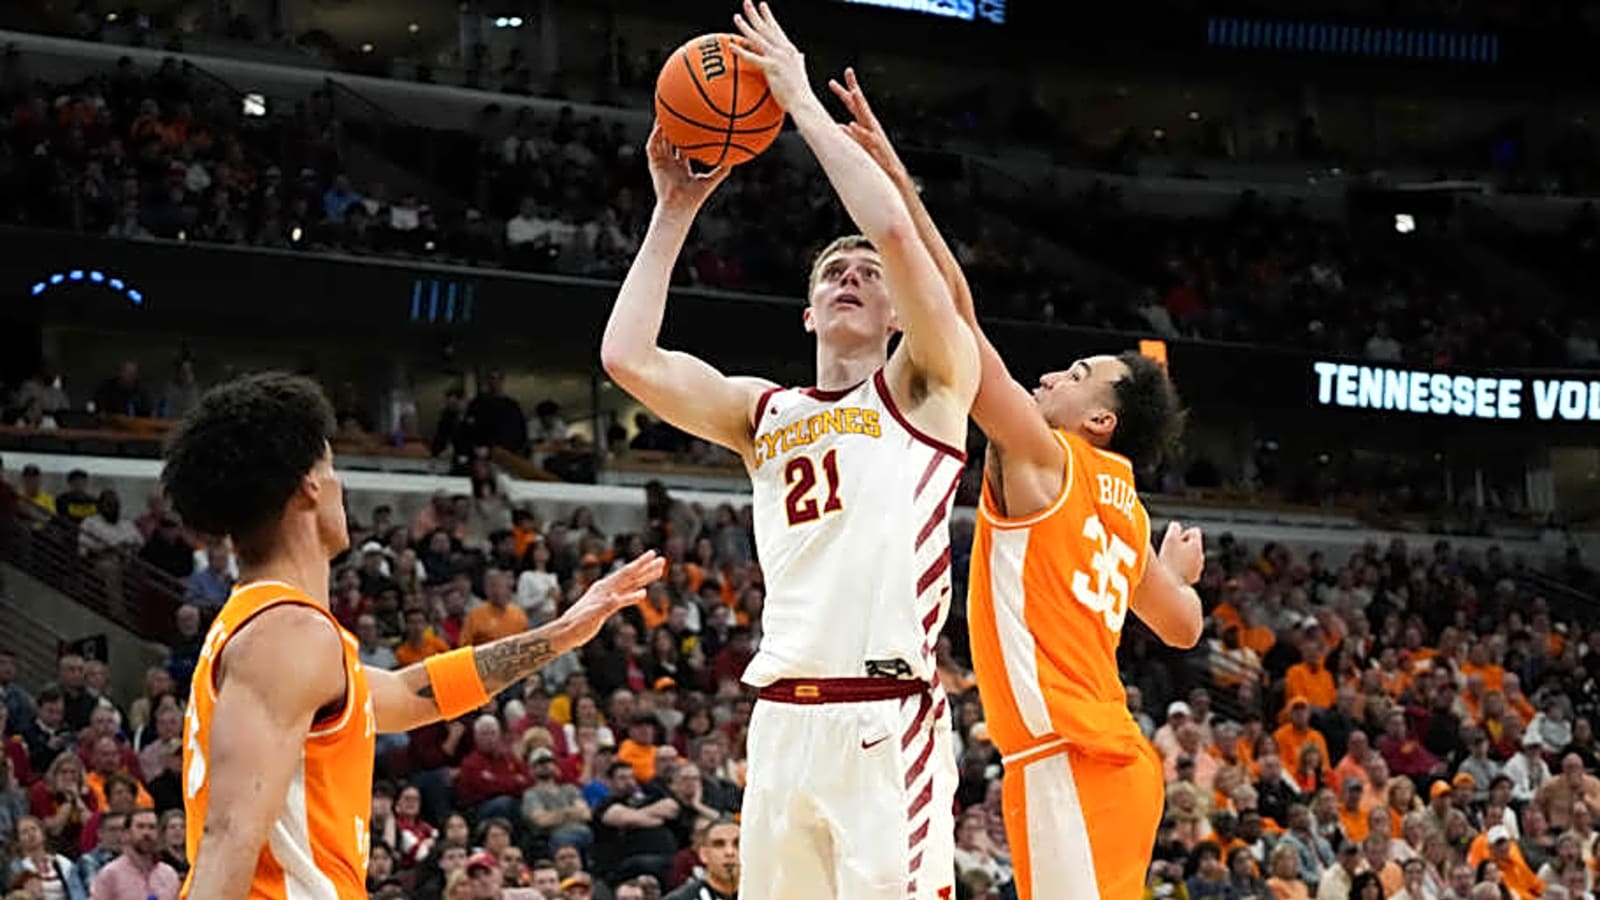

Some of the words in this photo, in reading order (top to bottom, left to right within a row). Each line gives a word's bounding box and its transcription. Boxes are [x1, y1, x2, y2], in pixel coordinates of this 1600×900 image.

[1314, 362, 1522, 419] TENNESSEE
[783, 448, 843, 526] 21
[1071, 513, 1138, 633] 35
